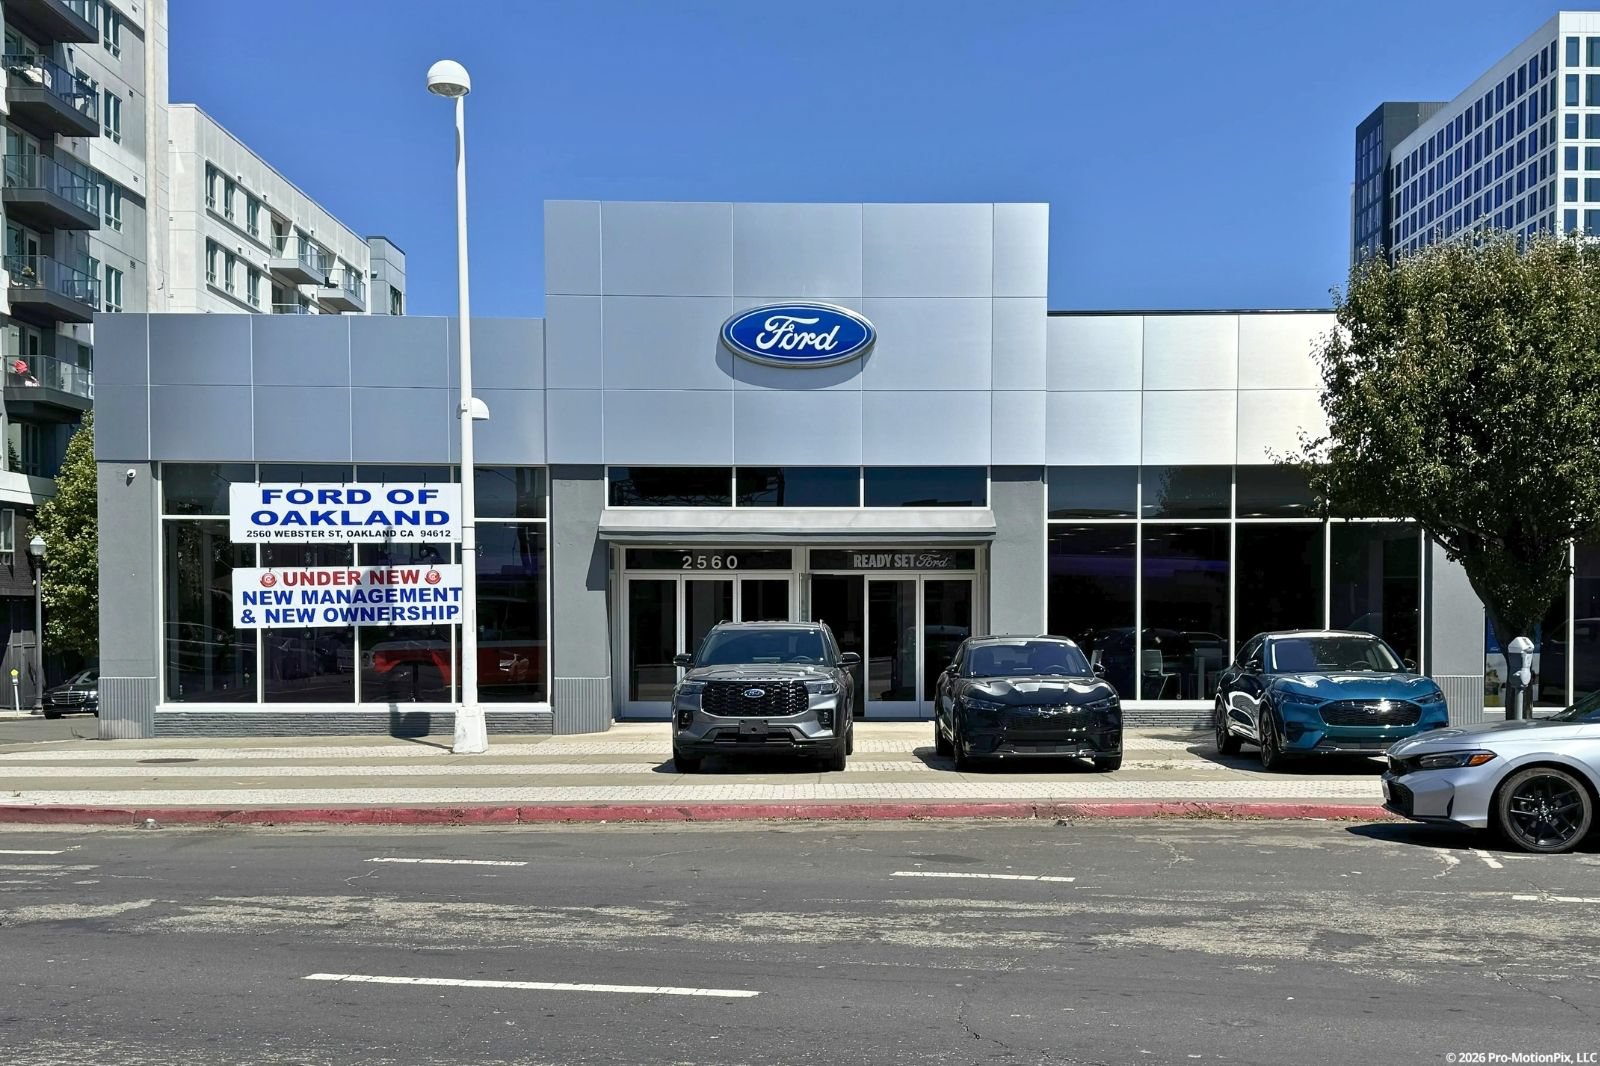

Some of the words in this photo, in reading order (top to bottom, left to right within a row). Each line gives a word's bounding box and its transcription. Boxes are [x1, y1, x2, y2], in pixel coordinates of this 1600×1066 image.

[756, 315, 840, 350] Ford
[261, 489, 371, 505] FORD
[386, 489, 439, 505] OF
[250, 510, 449, 526] OAKLAND
[246, 530, 271, 538] 2560
[274, 530, 325, 538] WEBSTER
[328, 530, 343, 539] ST,
[346, 529, 397, 538] OAKLAND
[400, 529, 414, 538] CA
[420, 529, 451, 538] 94612
[682, 555, 738, 569] 2560
[853, 554, 892, 568] READY
[894, 554, 916, 568] SET
[916, 553, 949, 568] Ford
[283, 571, 362, 586] UNDER
[369, 569, 420, 585] NEW
[242, 590, 294, 606] NEW
[301, 587, 462, 605] MANAGEMENT
[240, 610, 257, 624] &
[265, 607, 316, 624] NEW
[323, 605, 459, 623] OWNERSHIP
